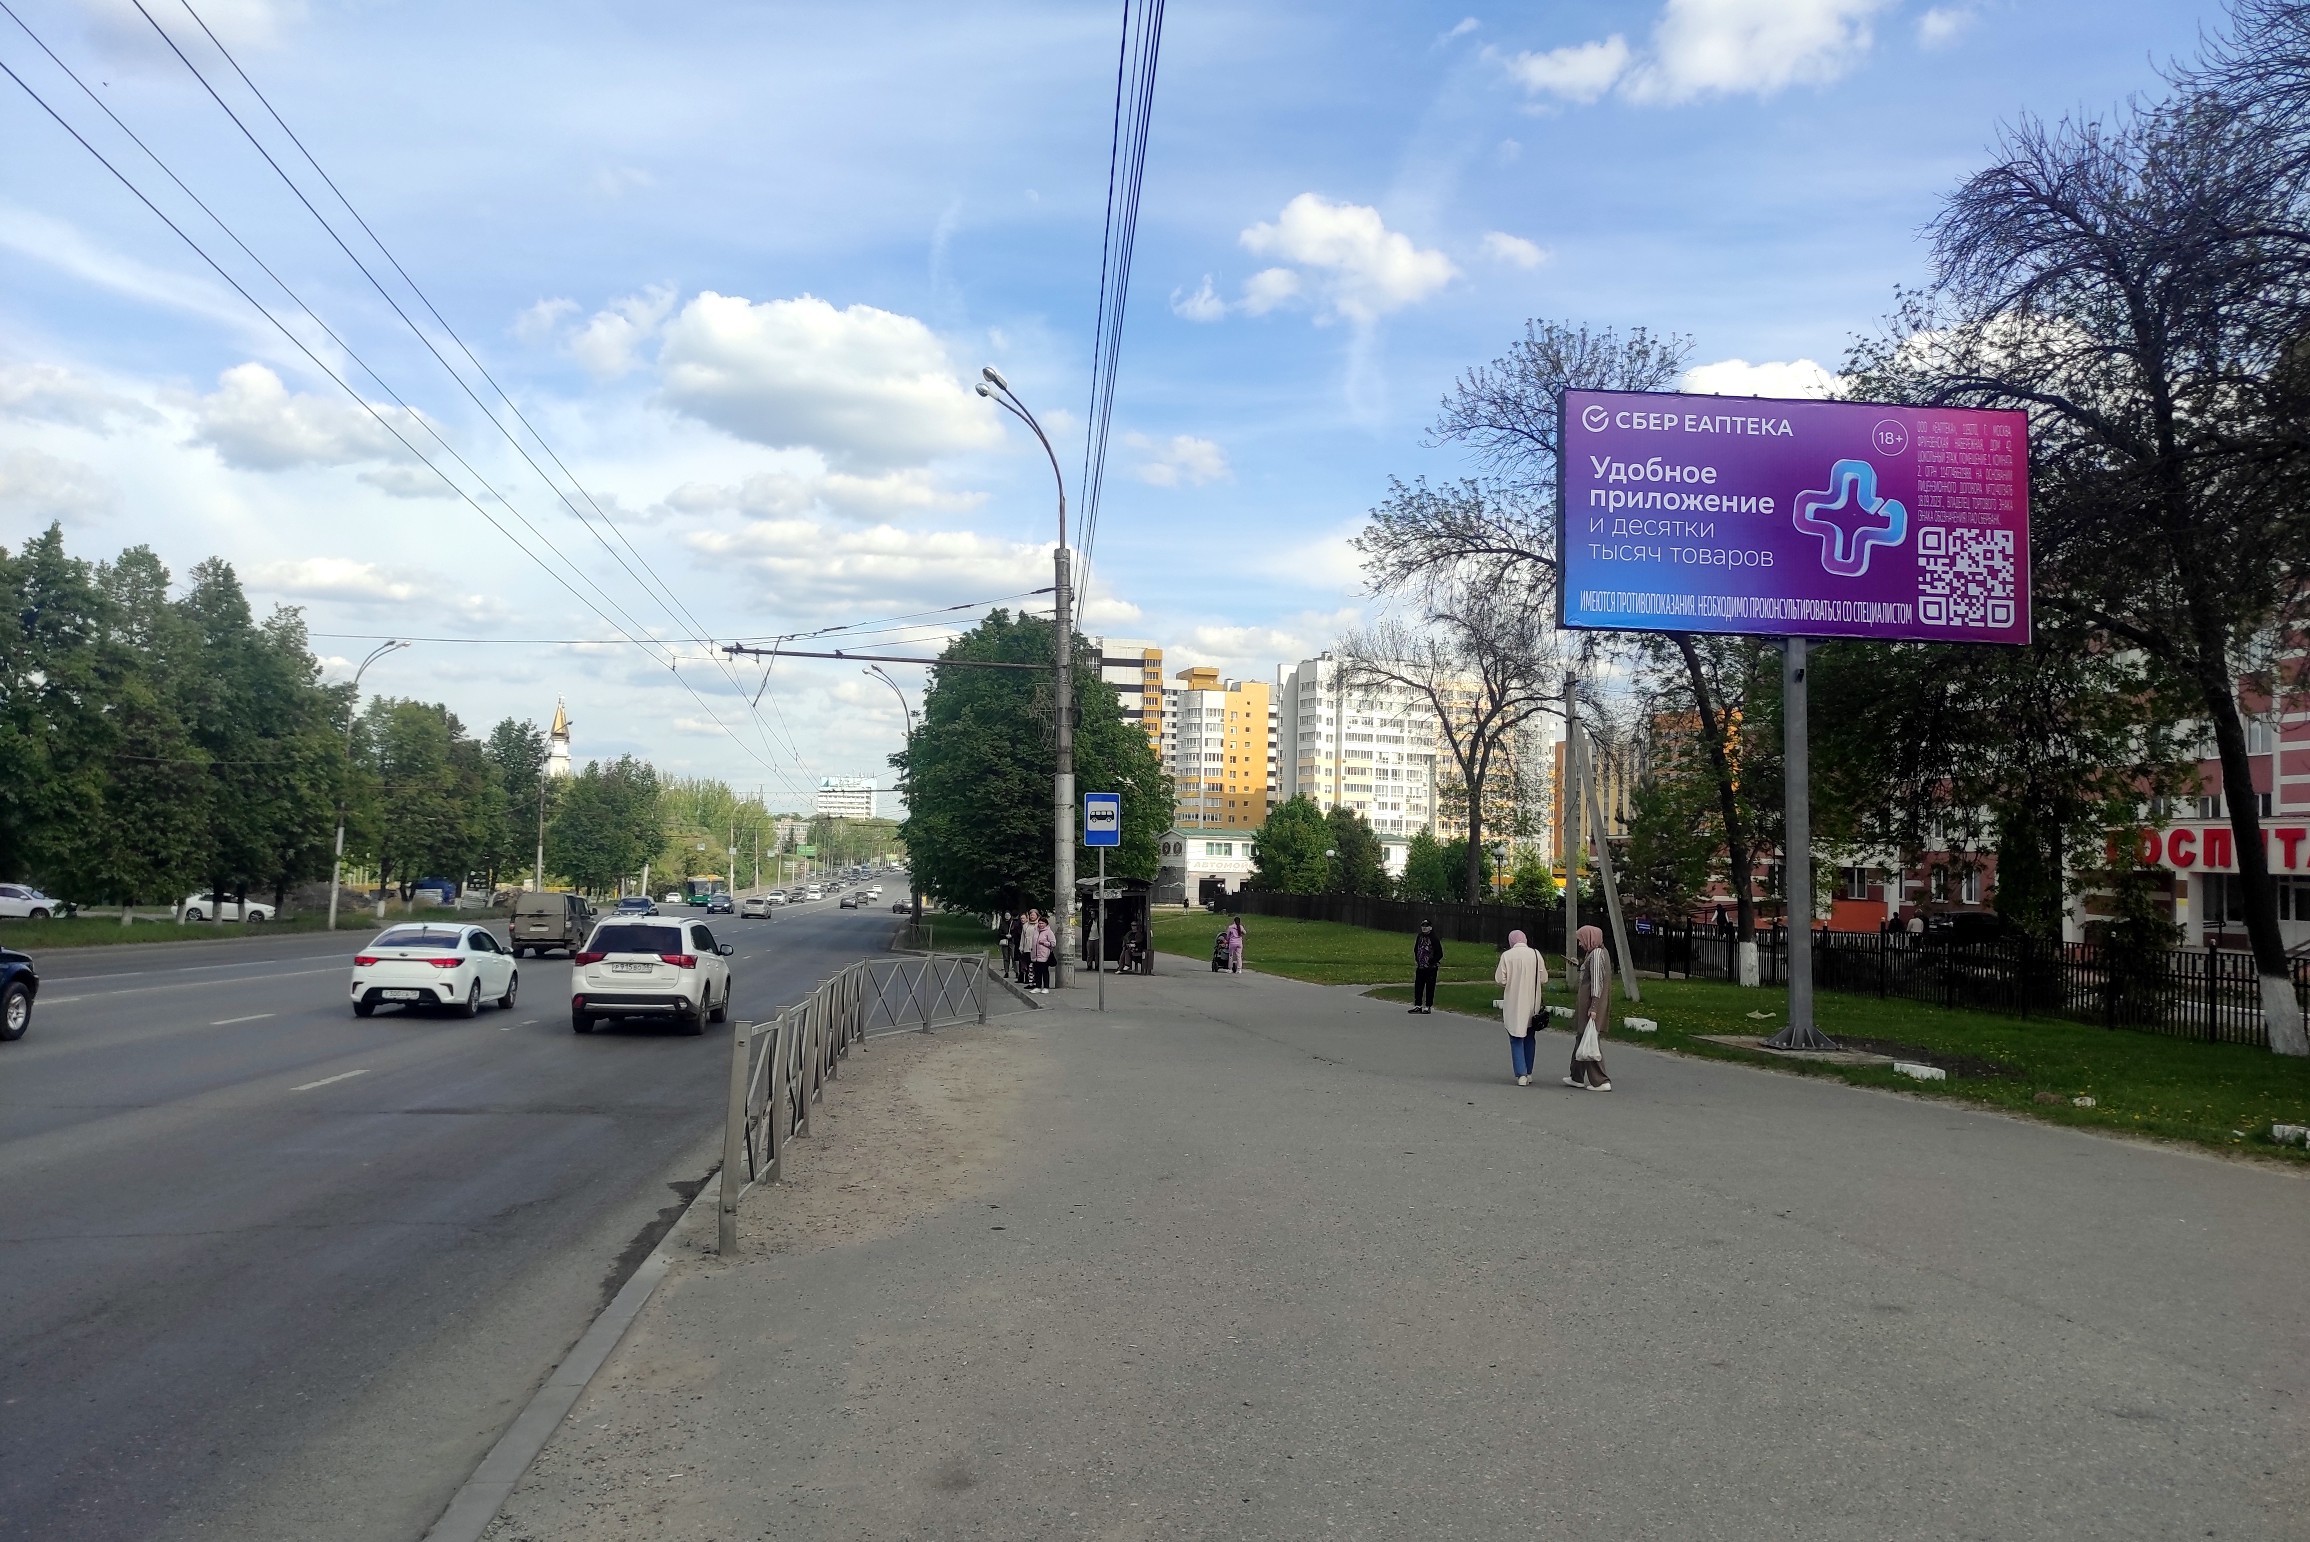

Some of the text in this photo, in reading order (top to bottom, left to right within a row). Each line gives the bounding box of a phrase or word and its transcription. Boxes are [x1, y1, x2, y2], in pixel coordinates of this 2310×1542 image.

[1615, 411, 1794, 436] СБЕР ЕАПТЕКА
[1878, 431, 1904, 445] 18+
[1589, 455, 1717, 484] Удобное
[1589, 488, 1775, 515] приложение
[1589, 517, 1715, 539] и десятки
[1588, 543, 1774, 570] тысяч товаров
[1580, 590, 1913, 628] ИМЕЮТСЯ ПРОТИВОПОКАЗАНИЯ. НЕОБХОДИМО ПРОКОНСУЛЬТИРОВАТЬСЯ СО СПЕЦИАЛИСТОМ
